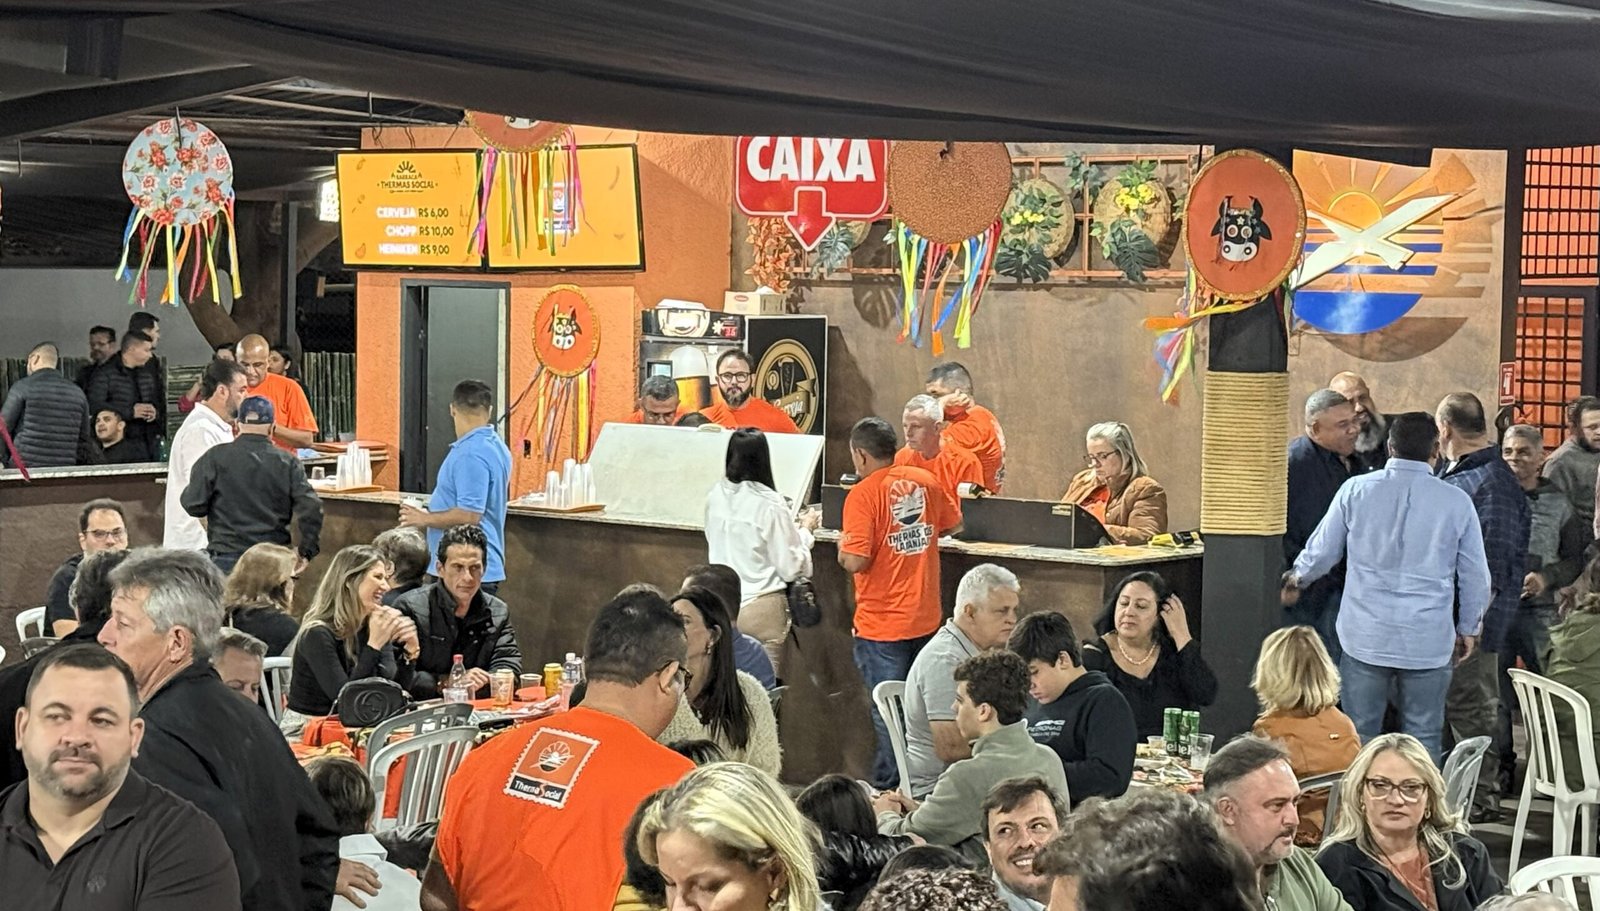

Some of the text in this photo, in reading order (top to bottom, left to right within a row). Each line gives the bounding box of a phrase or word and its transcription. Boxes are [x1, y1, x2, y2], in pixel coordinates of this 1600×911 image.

[746, 137, 876, 182] CAIXA
[381, 180, 434, 189] THERMAS SOCIAL
[376, 207, 449, 219] CERVEJA R$ 6,00
[385, 225, 454, 238] CHOPP R$ 10,00
[420, 244, 431, 255] R$
[432, 244, 450, 256] 9,00
[773, 398, 804, 418] Crveja
